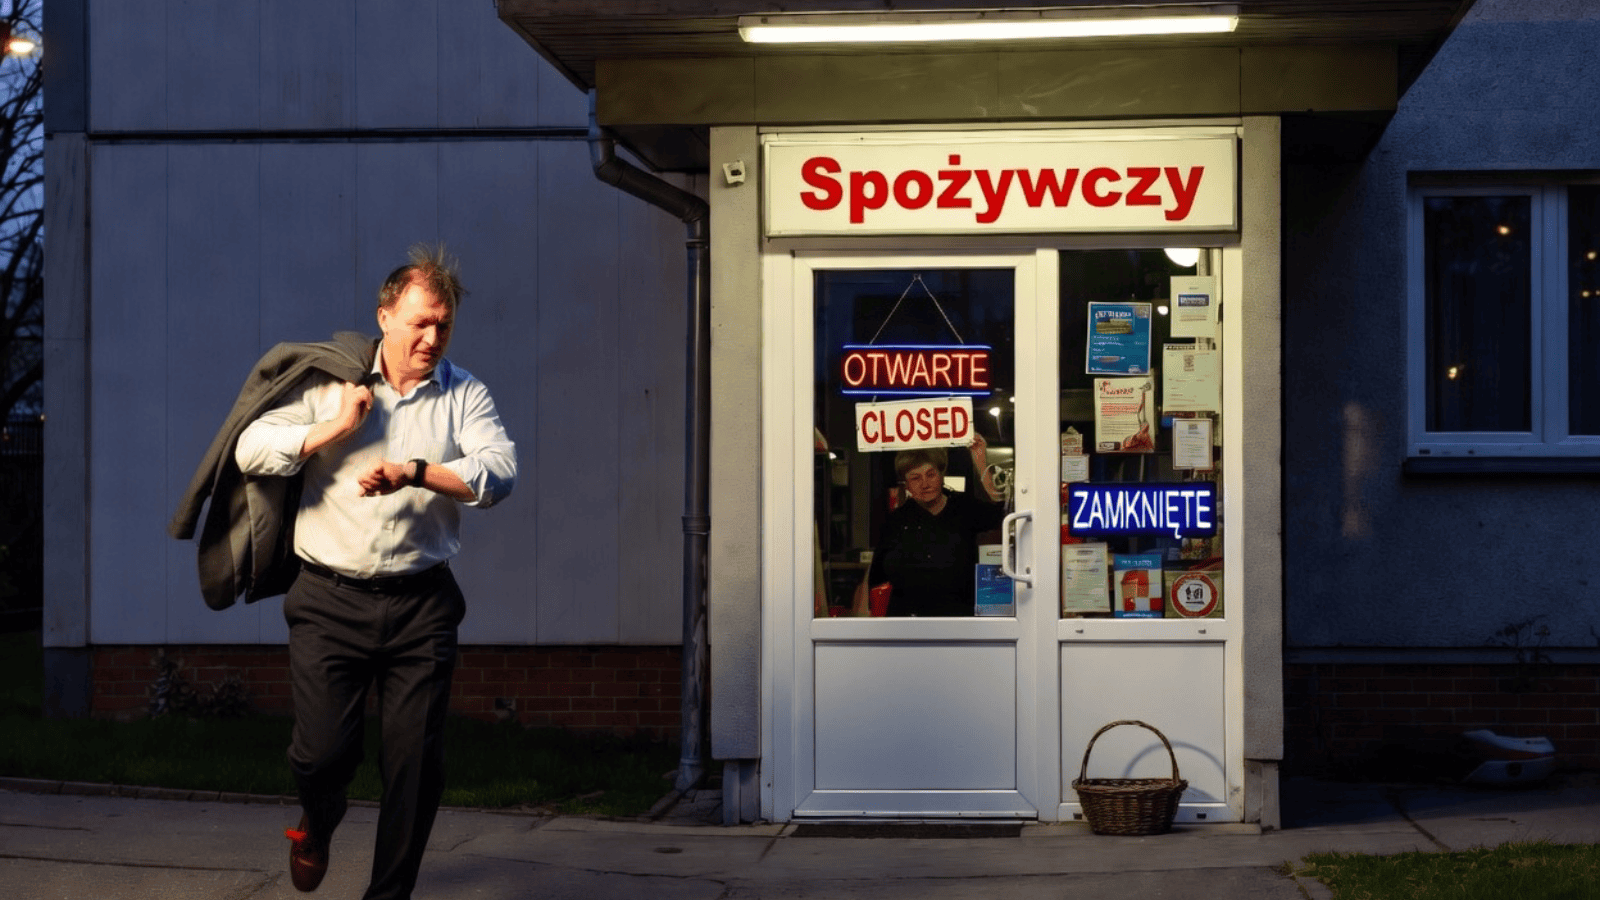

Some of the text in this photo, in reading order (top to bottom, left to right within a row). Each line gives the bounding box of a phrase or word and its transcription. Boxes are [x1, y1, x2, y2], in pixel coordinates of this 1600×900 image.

[800, 154, 1204, 224] Spożywczy
[844, 353, 988, 387] OTWARTE
[861, 406, 968, 444] CLOSED
[1073, 490, 1212, 539] ZAMKNIĘTE
